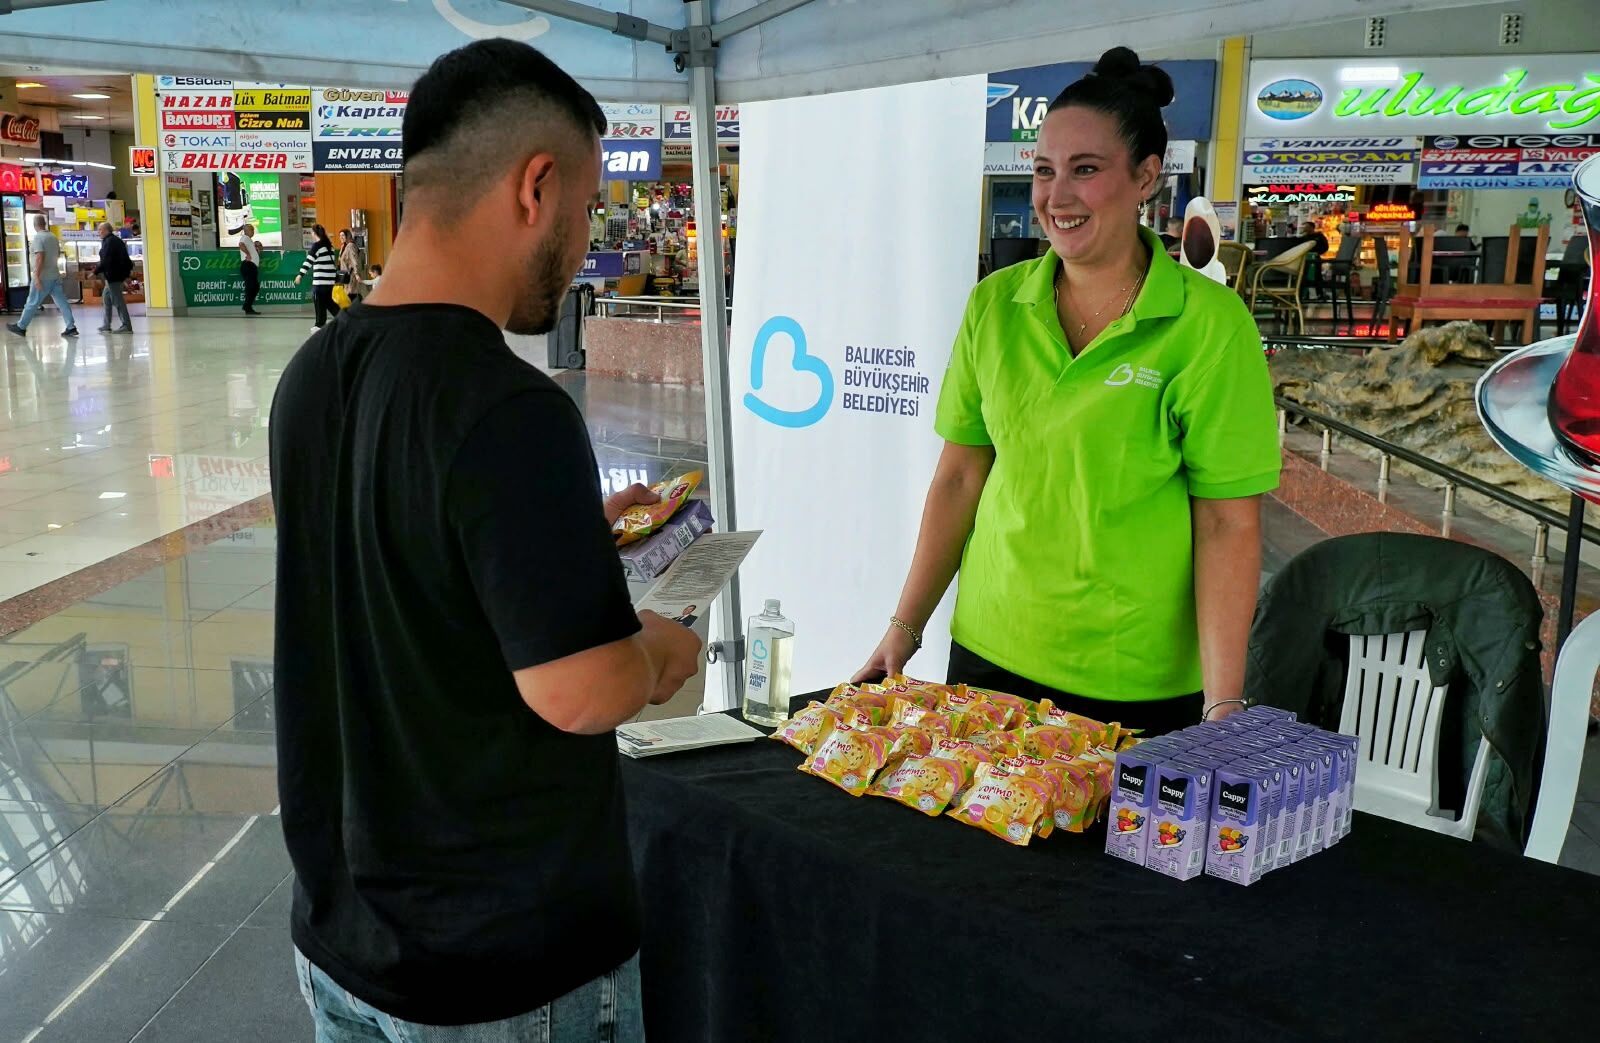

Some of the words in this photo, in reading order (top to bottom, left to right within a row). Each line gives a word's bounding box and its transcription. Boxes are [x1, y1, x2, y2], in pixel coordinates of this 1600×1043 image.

[234, 92, 255, 106] Lüx
[263, 93, 309, 106] Batman
[323, 88, 384, 101] Güven
[164, 96, 232, 107] HAZAR
[1012, 97, 1049, 130] KÂ
[165, 114, 231, 126] BAYBURT
[238, 118, 273, 128] Cizre
[276, 117, 304, 128] Nuh
[180, 136, 231, 147] TOKAT
[1282, 138, 1403, 147] VANGÖLÜ
[133, 150, 154, 167] WC
[328, 149, 381, 159] ENVER
[384, 149, 403, 159] GE
[1272, 152, 1411, 163] TOPÇAM
[1423, 153, 1517, 162] SARIKIZ
[1546, 152, 1595, 161] YALO
[181, 153, 287, 168] BALIKESİR
[1427, 163, 1508, 173] JET
[182, 256, 201, 270] 50
[197, 280, 226, 290] EDREMİT
[232, 281, 245, 291] AKÇ
[260, 280, 296, 289] ALTINOLUK
[194, 292, 234, 304] KÜÇÜKKUYU
[265, 292, 302, 302] ÇANAKKALE
[845, 346, 915, 368] BALIKESİR
[844, 366, 929, 394] BÜYÜKŞEHİR
[843, 392, 919, 416] BELEDİYESİ
[1122, 773, 1143, 786] Cappy
[1162, 785, 1184, 799] Cappy
[1223, 790, 1246, 804] Cappy
